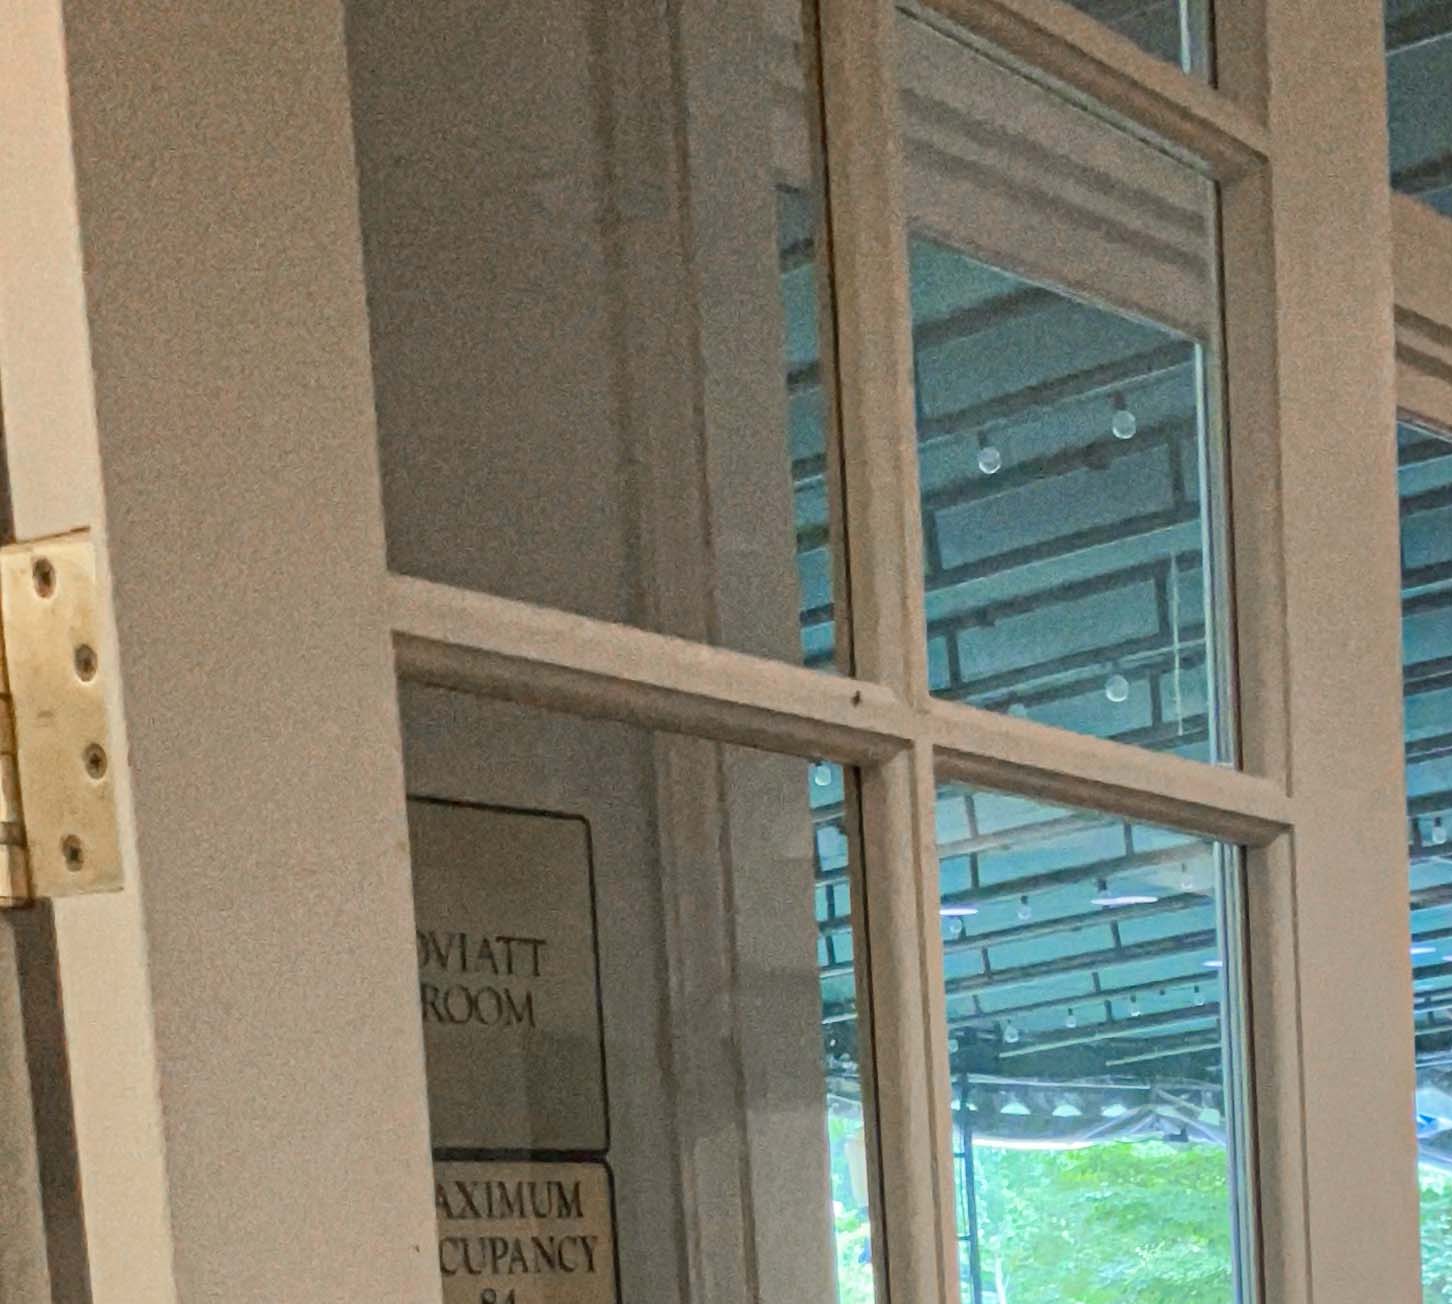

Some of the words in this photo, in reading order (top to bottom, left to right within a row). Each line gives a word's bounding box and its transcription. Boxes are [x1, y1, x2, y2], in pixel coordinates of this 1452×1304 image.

[420, 983, 536, 1028] ROOM
[436, 1180, 585, 1220] AXIMUM
[439, 1235, 598, 1276] CUPANCY
